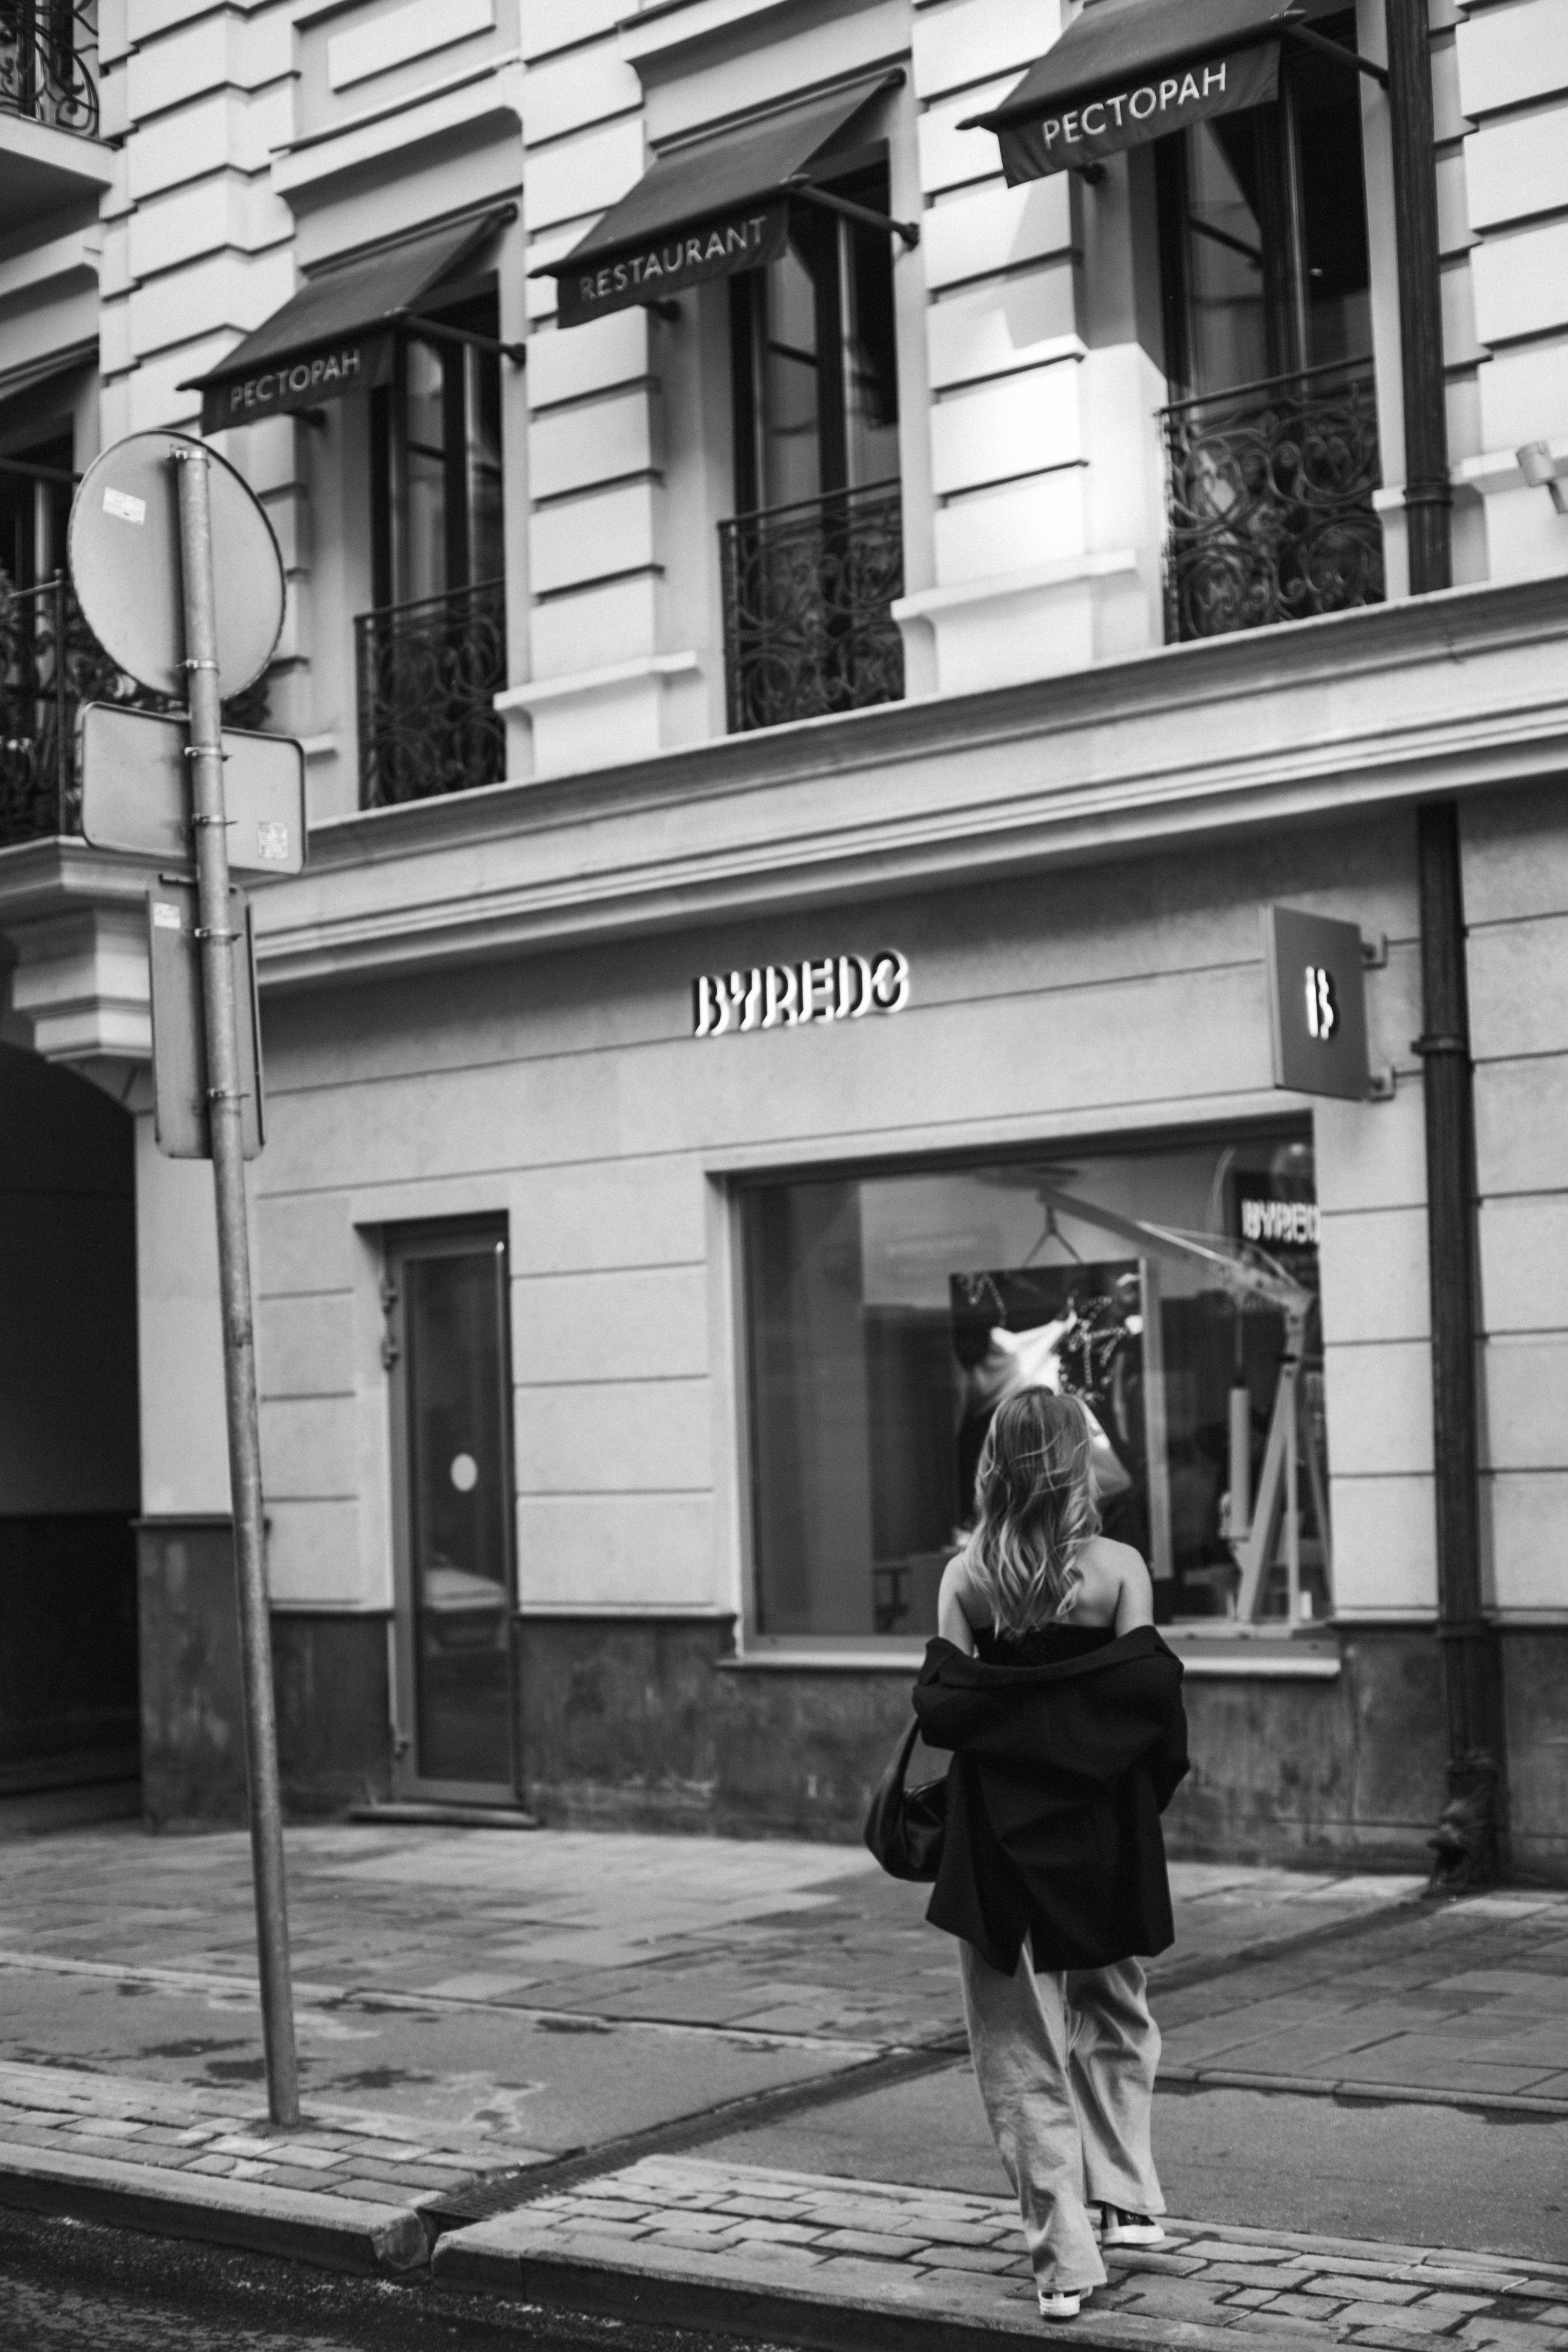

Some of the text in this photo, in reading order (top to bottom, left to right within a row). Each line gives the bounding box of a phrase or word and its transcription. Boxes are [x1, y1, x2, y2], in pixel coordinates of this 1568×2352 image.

[1043, 62, 1226, 150] РЕСТОРАН
[579, 216, 767, 303] RESTAURANT
[230, 349, 361, 411] РЕСТОРАН
[692, 949, 910, 1037] BYREDO
